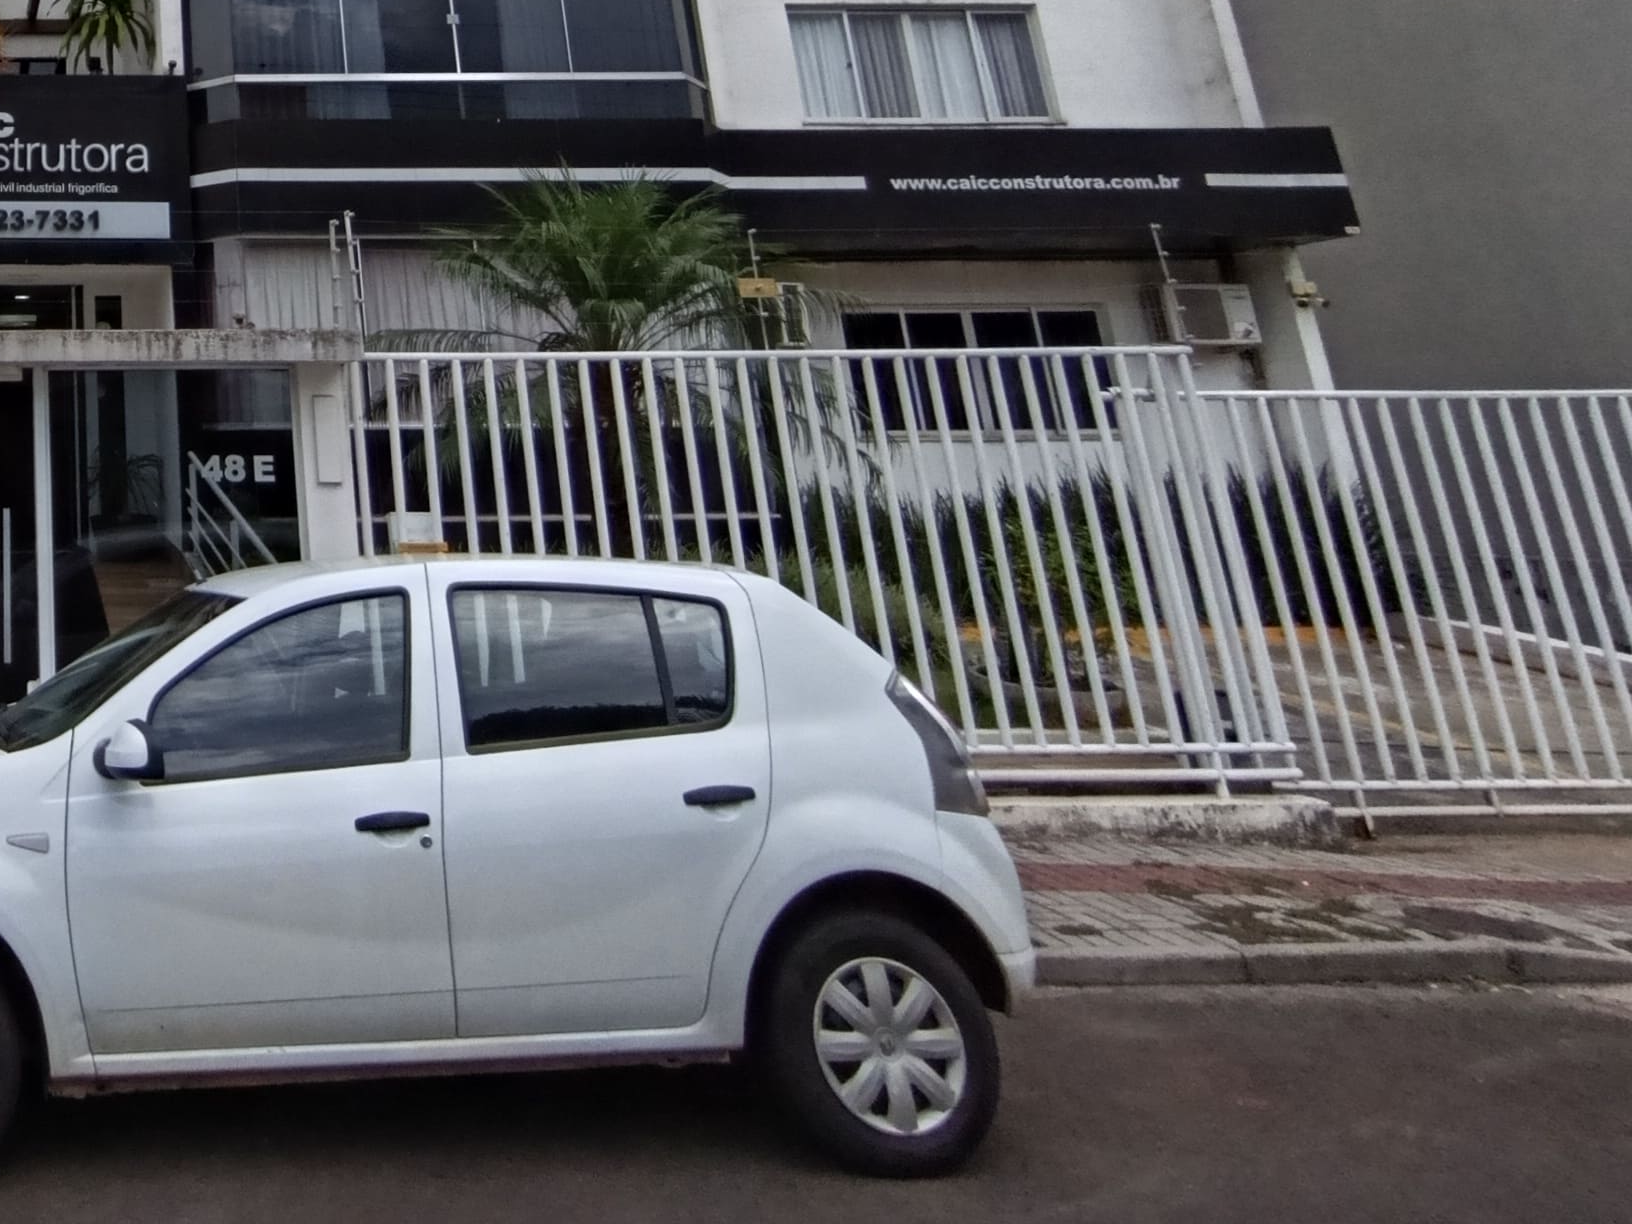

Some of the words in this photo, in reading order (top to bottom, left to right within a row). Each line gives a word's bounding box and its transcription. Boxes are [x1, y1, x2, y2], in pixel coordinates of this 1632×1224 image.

[16, 182, 65, 193] industrial
[889, 174, 1181, 191] www.caicconstrutora.com.br
[201, 454, 246, 483] 48
[253, 455, 276, 483] E
